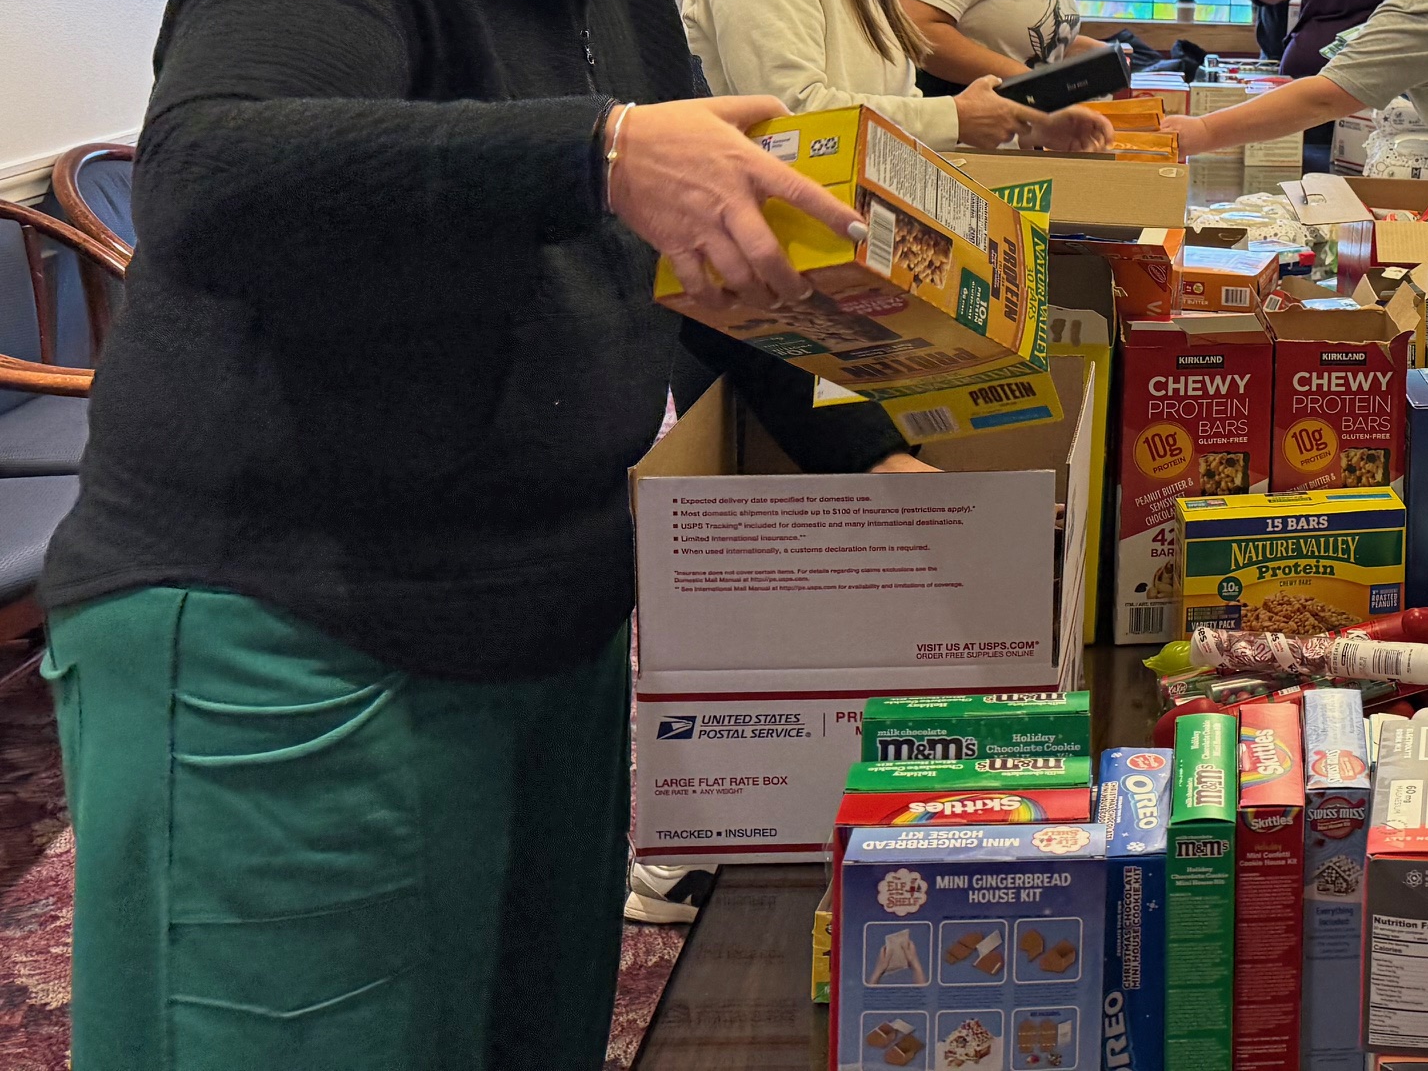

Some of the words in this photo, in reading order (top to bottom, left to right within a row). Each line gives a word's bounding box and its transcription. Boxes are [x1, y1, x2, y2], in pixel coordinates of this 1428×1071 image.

[1003, 237, 1021, 323] PROTEIN
[1178, 355, 1223, 364] KIRKLAND
[1148, 374, 1251, 397] CHEWY
[1292, 371, 1393, 392] CHEWY
[969, 382, 1037, 407] PROTEIN
[1148, 398, 1249, 419] PROTEIN
[1292, 395, 1391, 414] PROTEIN
[1198, 420, 1248, 436] BARS
[1342, 416, 1391, 431] BARS
[1143, 431, 1183, 463] 10g
[1198, 436, 1248, 445] GLUTEN-FREE
[1291, 427, 1328, 455] 10g
[1153, 456, 1187, 474] PROTEIN
[1300, 451, 1331, 467] PROTEIN
[1135, 490, 1161, 507] PEANUT
[1162, 480, 1187, 496] BUTTER
[1188, 477, 1193, 486] &
[740, 509, 779, 517] shipments
[1266, 518, 1283, 531] 15
[1287, 516, 1328, 530] BARS
[1230, 539, 1297, 570] NATURE
[1299, 536, 1360, 563] VALLEY
[1256, 560, 1336, 580] Protein
[1371, 593, 1398, 601] ROASTED
[1371, 600, 1398, 608] PEANUTS
[1219, 620, 1235, 629] PACK
[916, 643, 943, 652] VISIT
[945, 643, 960, 651] US
[962, 642, 976, 651] AT
[916, 652, 943, 660] ORDER
[945, 651, 965, 659] FREE
[966, 650, 1004, 658] SUPPLIES
[702, 714, 753, 725] UNITED
[754, 713, 801, 724] STATES
[698, 728, 748, 739] POSTAL
[1012, 733, 1056, 743] Holiday
[986, 744, 1043, 753] Chocolate
[1044, 743, 1081, 752] Cookie
[1254, 729, 1284, 775] Skittles
[655, 779, 695, 788] LARGE
[699, 778, 724, 787] FLAT
[729, 777, 759, 786] RATE
[762, 776, 788, 785] BOX
[1405, 785, 1416, 794] 60
[908, 796, 1023, 816] Skittles
[1123, 774, 1158, 829] OREO
[1250, 816, 1294, 830] Skittles
[656, 829, 713, 840] TRACKED
[725, 828, 777, 838] INSURED
[898, 831, 925, 840] KIT
[927, 831, 983, 839] HOUSE
[862, 838, 981, 850] GINGERBREAD
[983, 838, 1020, 848] MINI
[935, 874, 968, 889] MINI
[972, 872, 1071, 889] GINGERBREAD
[968, 889, 1016, 904] HOUSE
[1020, 888, 1042, 902] KIT
[1124, 867, 1133, 929] CHOCOLATE
[1133, 887, 1141, 926] COOKIE
[1373, 916, 1418, 929] Nutrition
[1132, 928, 1140, 963] HOUSE
[1373, 945, 1403, 954] Calories
[1123, 930, 1132, 989] CHRISTMAS
